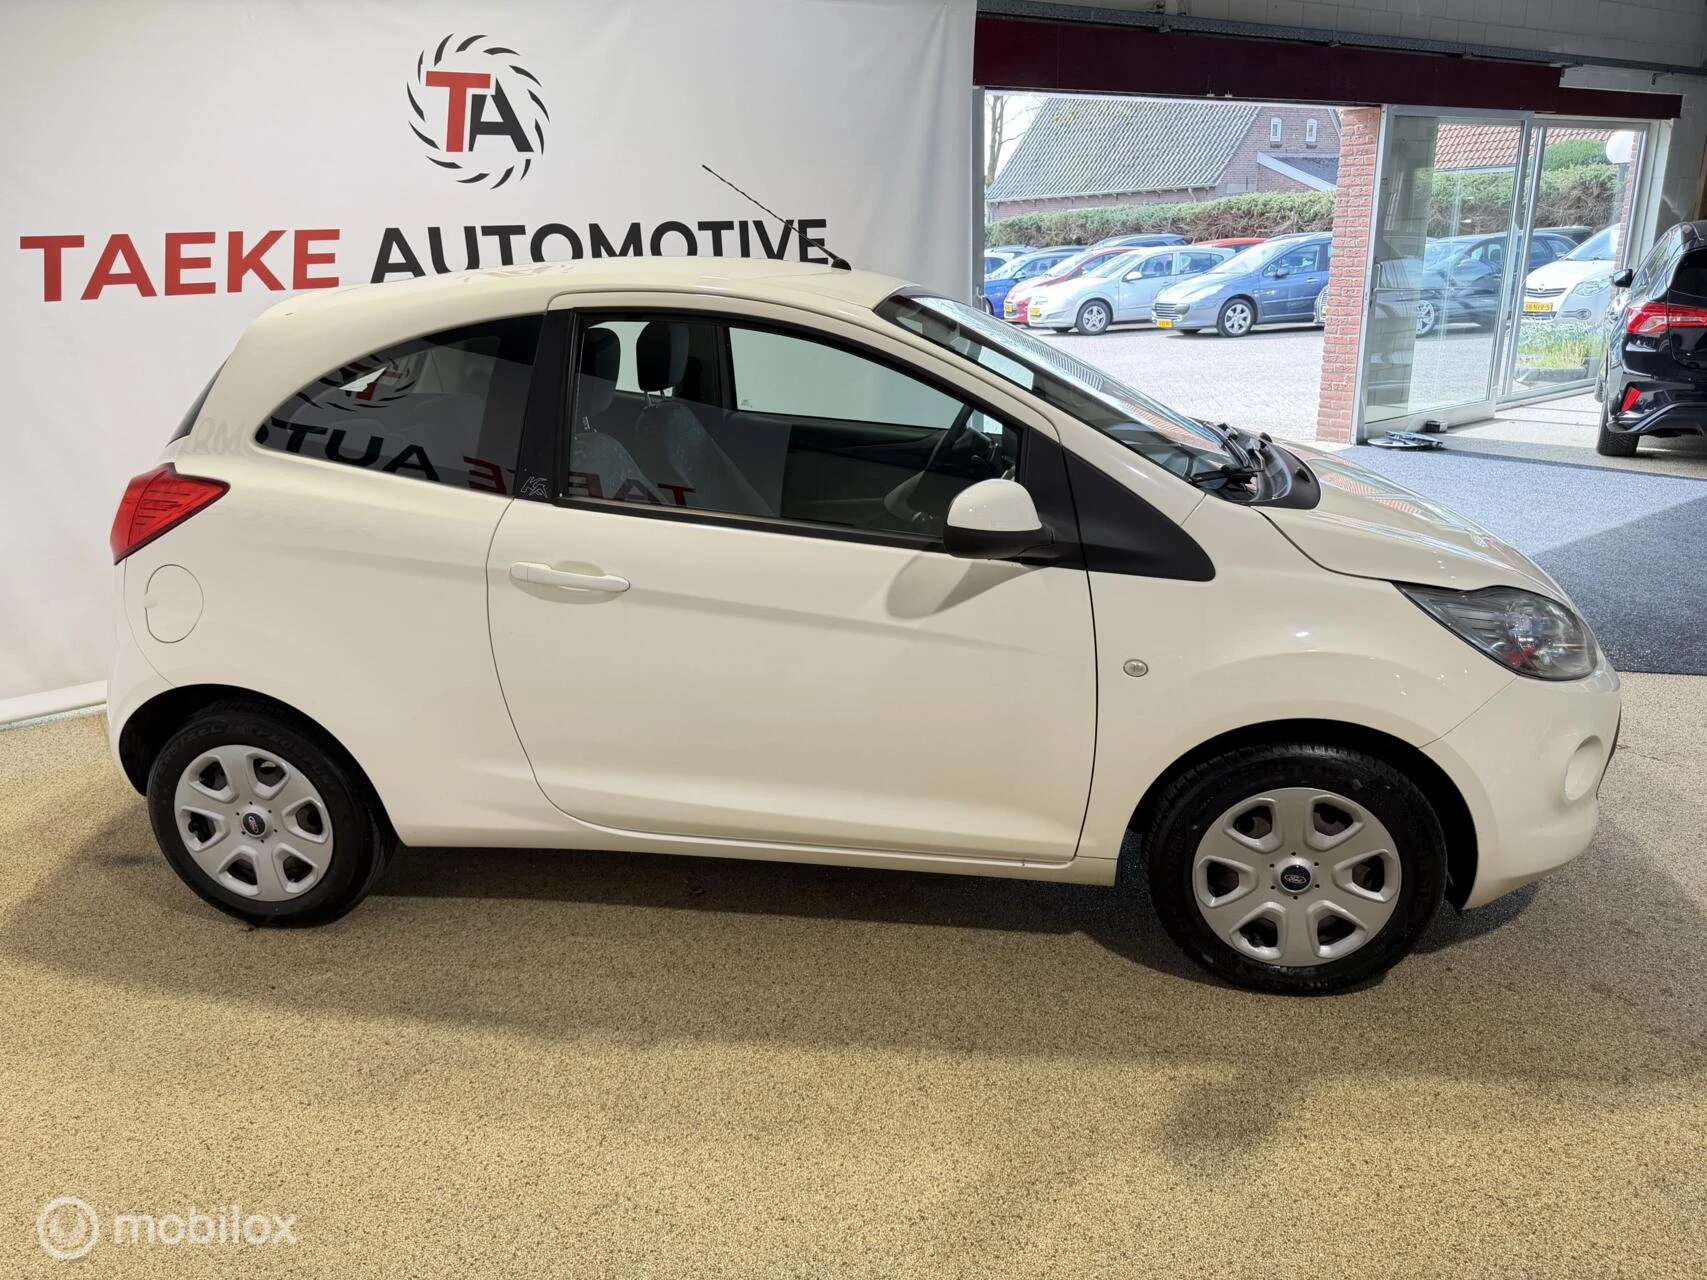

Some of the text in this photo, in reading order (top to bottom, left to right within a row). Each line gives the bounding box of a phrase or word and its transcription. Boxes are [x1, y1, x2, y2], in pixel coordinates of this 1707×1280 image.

[425, 70, 534, 152] TA
[20, 218, 829, 302] TAEKE AUTOMOTIVE
